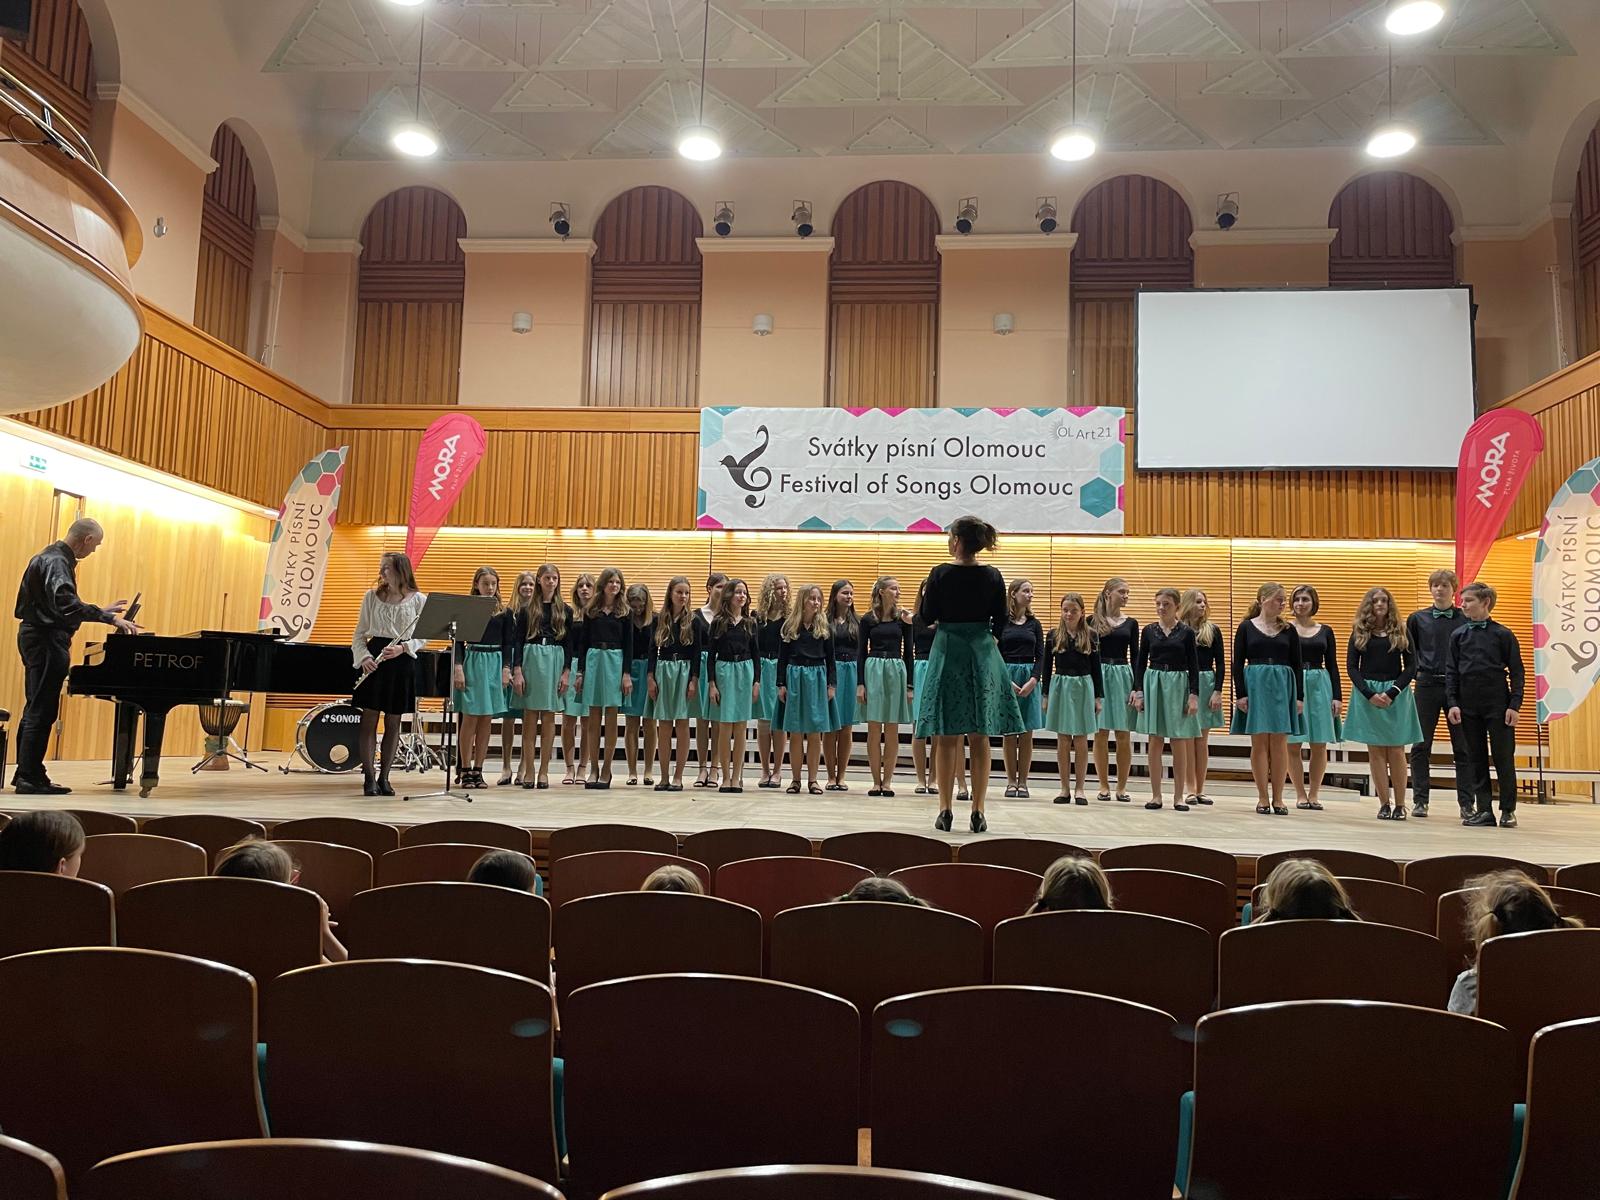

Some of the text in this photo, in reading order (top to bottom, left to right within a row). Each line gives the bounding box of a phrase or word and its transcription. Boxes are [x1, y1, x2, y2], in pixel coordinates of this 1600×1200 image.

[427, 434, 461, 500] MORA
[808, 435, 1046, 463] Svátky písní Olomouc
[1475, 432, 1511, 508] MORA
[780, 472, 1073, 500] Festival of Songs Olomouc
[280, 501, 306, 606] SVÁTKY PÍSNÍ
[297, 504, 323, 607] OLOMOUC
[1555, 515, 1578, 632] SVÁTKY PÍSNÍ
[1584, 517, 1600, 632] OLOMOUC
[133, 652, 206, 669] PETROF
[330, 714, 361, 723] SONOR
